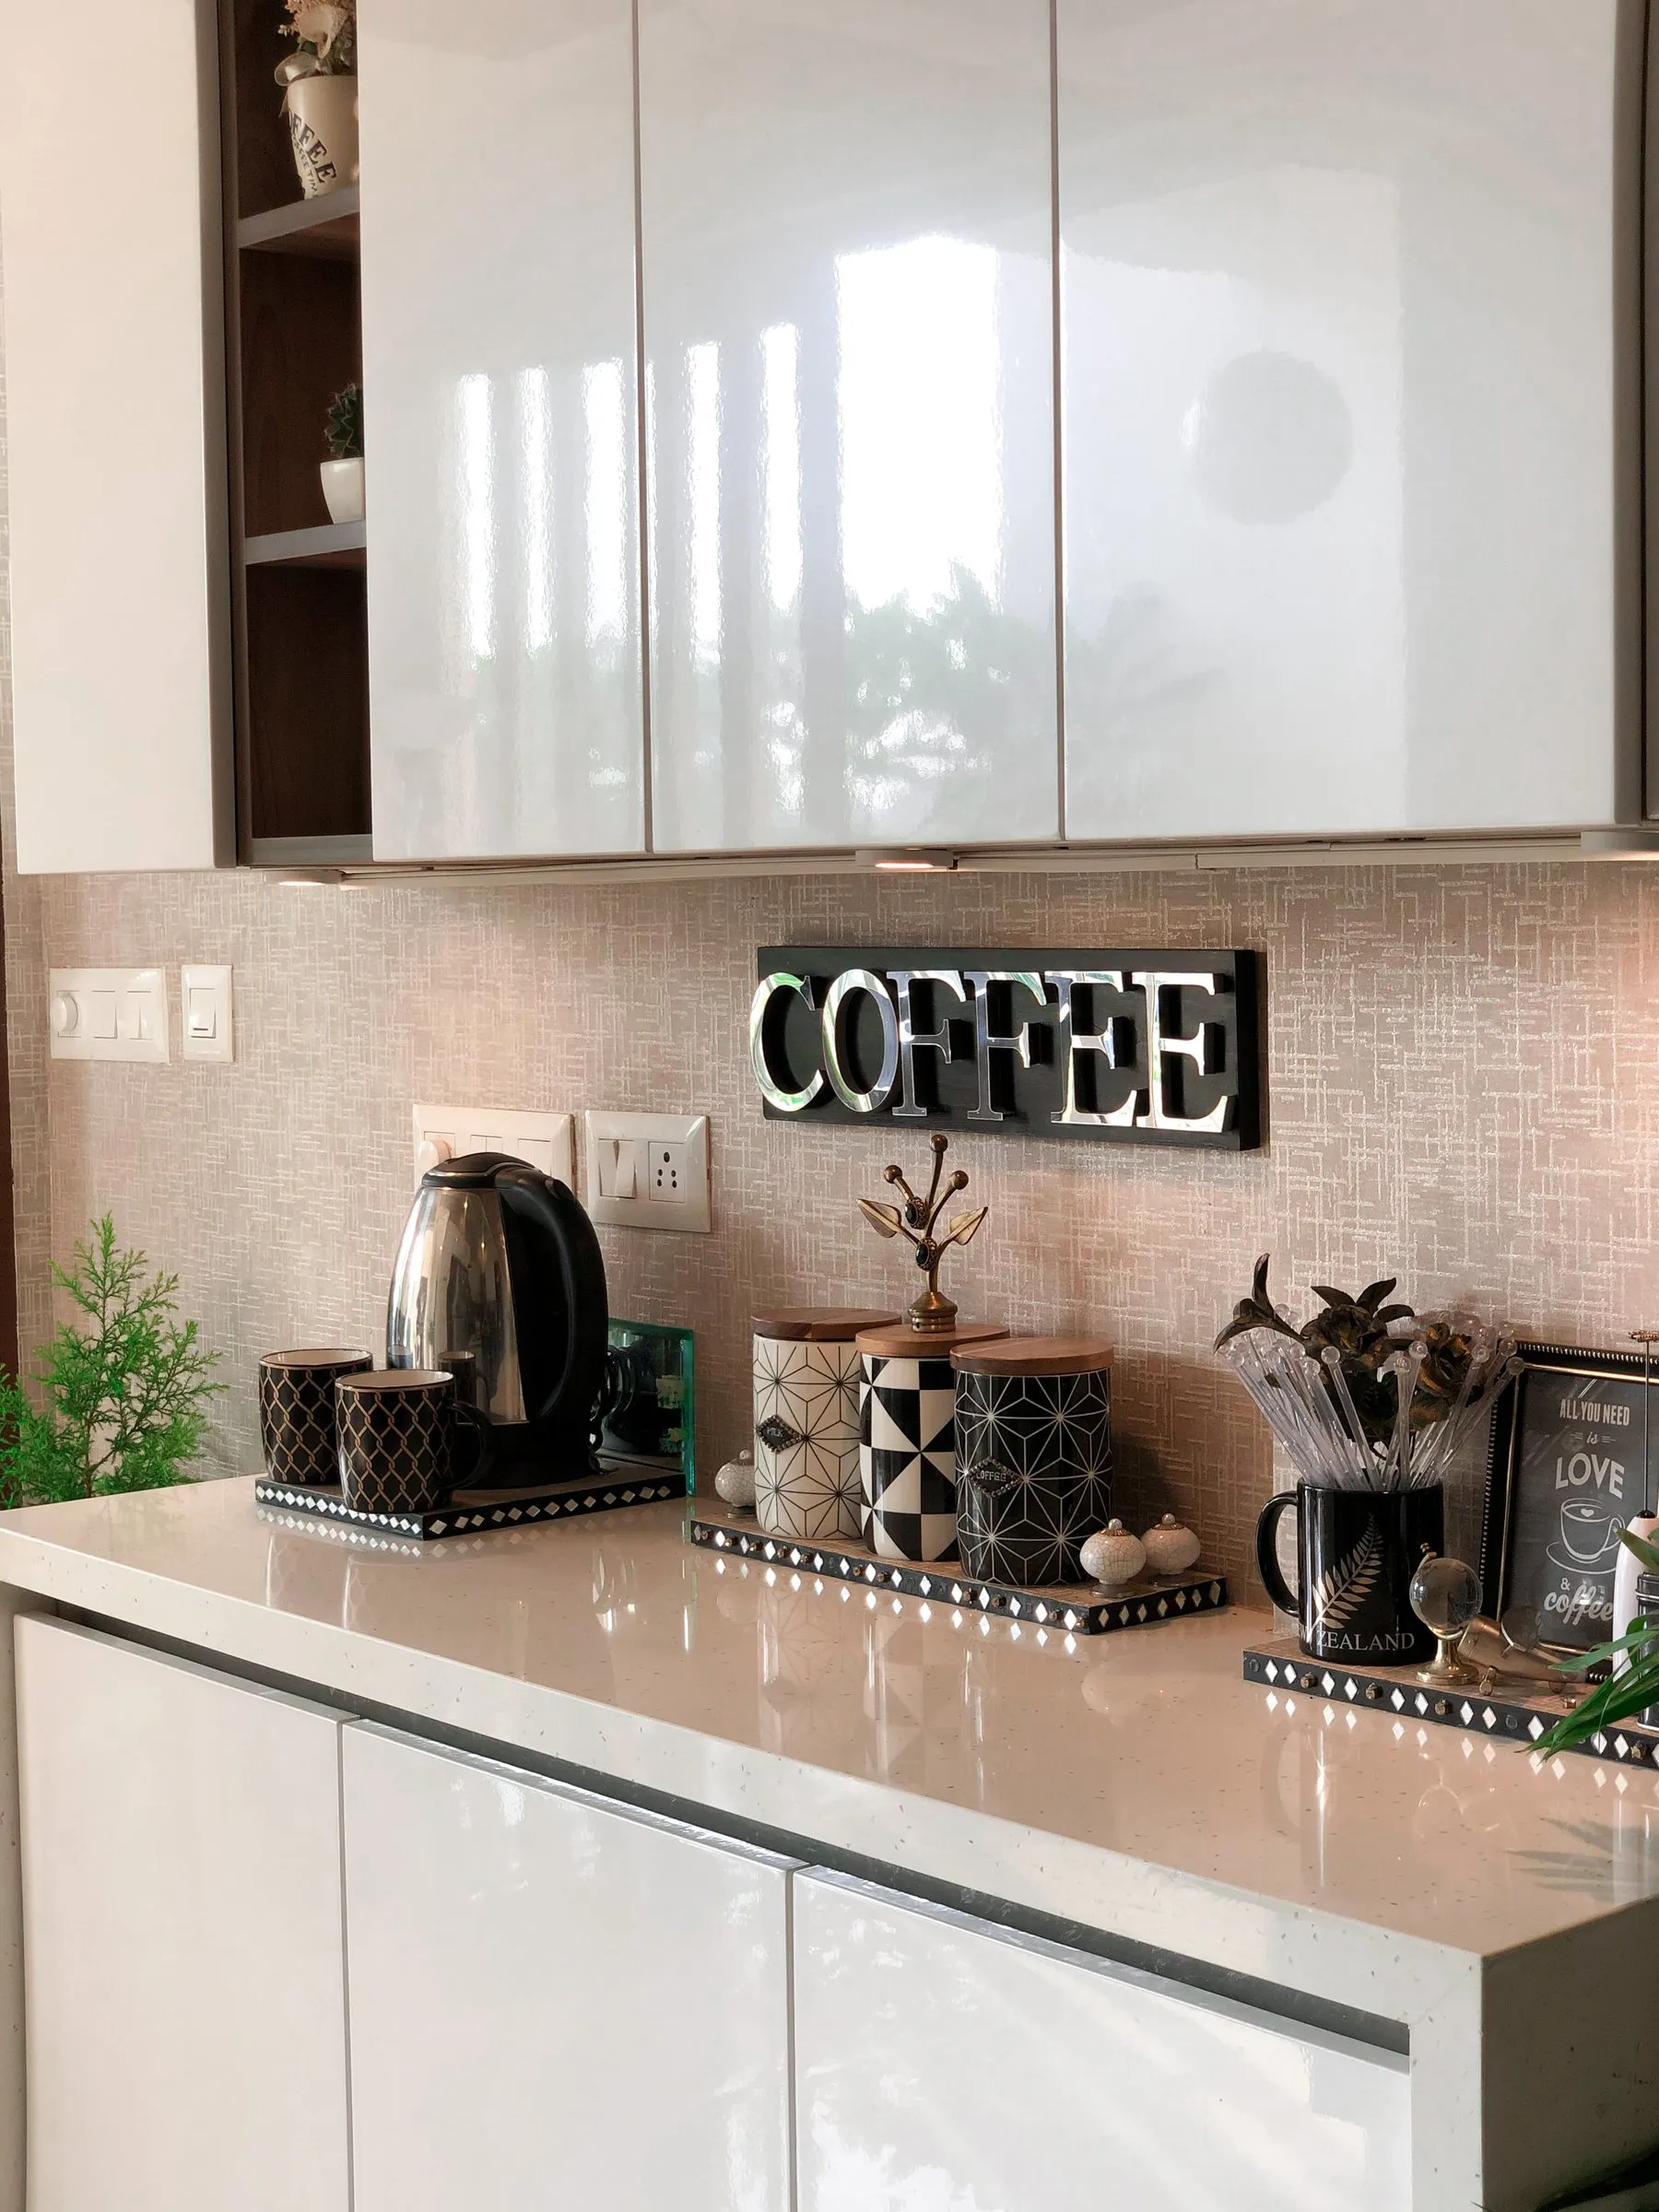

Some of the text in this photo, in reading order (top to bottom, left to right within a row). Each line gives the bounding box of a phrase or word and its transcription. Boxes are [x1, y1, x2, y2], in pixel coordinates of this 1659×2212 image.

[749, 969, 1229, 1133] COFFEE
[1559, 1399, 1630, 1426] ALL YOU NEED
[1586, 1431, 1599, 1444] is
[976, 1470, 1006, 1482] COFFEE
[1556, 1453, 1625, 1500] LOVE
[1560, 1577, 1571, 1591] &
[1544, 1583, 1614, 1625] coffee
[1316, 1630, 1415, 1651] ZEALAND
